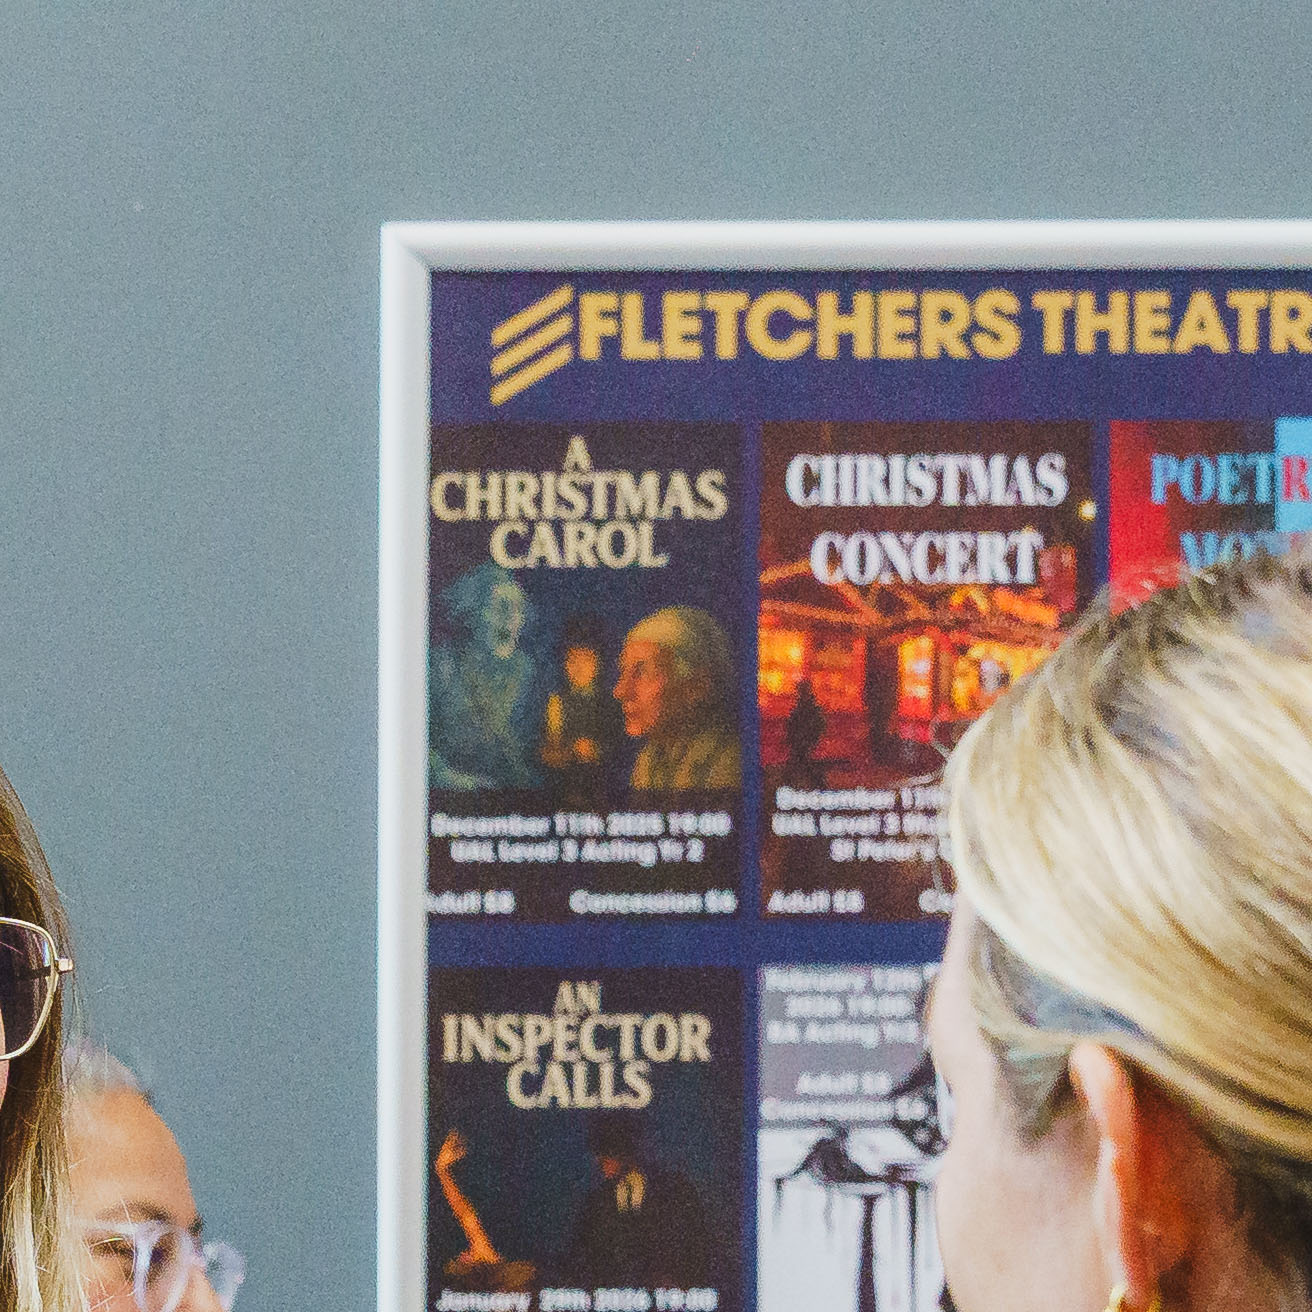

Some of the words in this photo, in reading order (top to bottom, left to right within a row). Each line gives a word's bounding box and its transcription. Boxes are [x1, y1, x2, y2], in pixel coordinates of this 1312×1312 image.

[579, 289, 1022, 359] FLETCHERS
[563, 435, 593, 472] A
[431, 469, 728, 521] CHRISTMAS
[786, 452, 1069, 507] CHRISTMAS
[490, 521, 670, 569] CAROL
[811, 531, 1044, 585] CONCERT
[553, 980, 602, 1015] AN
[442, 1013, 712, 1063] INSPECTOR
[506, 1060, 653, 1110] CALLS
